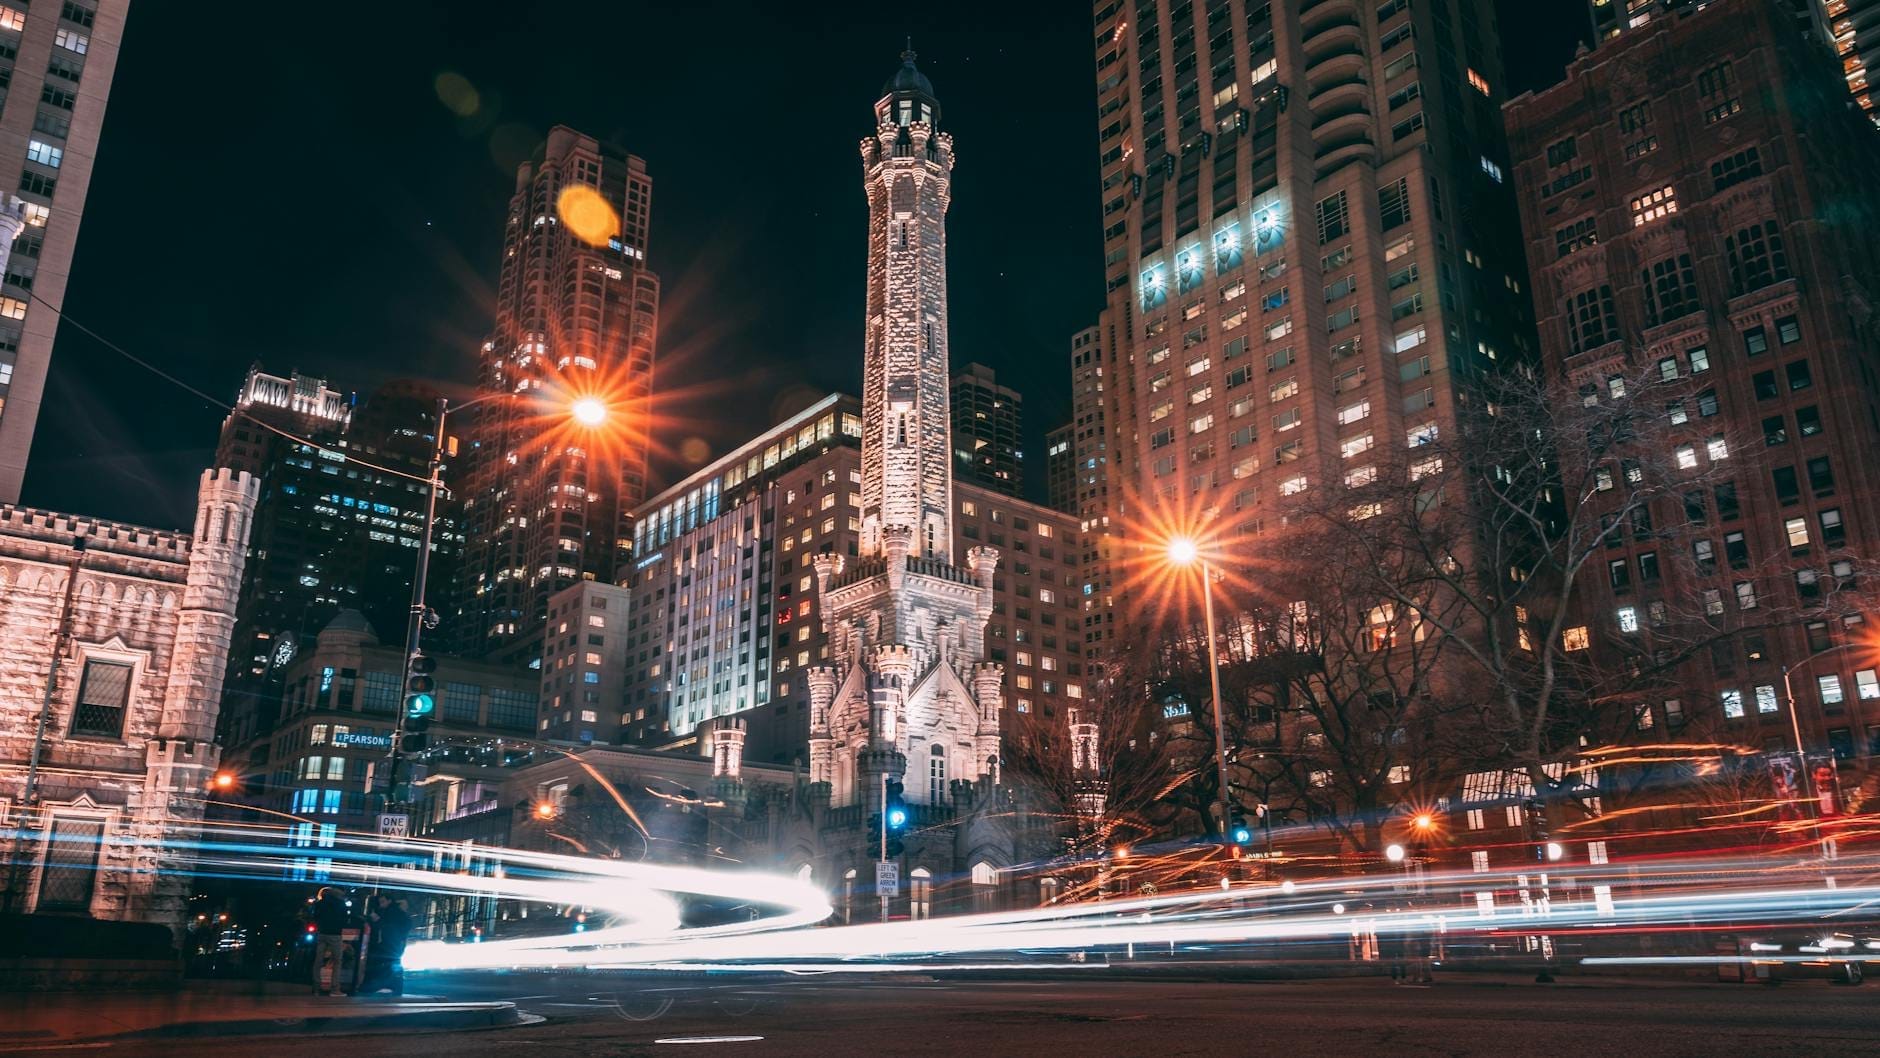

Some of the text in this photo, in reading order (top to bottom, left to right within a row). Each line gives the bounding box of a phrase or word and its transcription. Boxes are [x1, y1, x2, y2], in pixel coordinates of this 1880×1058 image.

[343, 734, 385, 745] PEARSON
[383, 817, 404, 827] ONE
[382, 826, 403, 836] WAY
